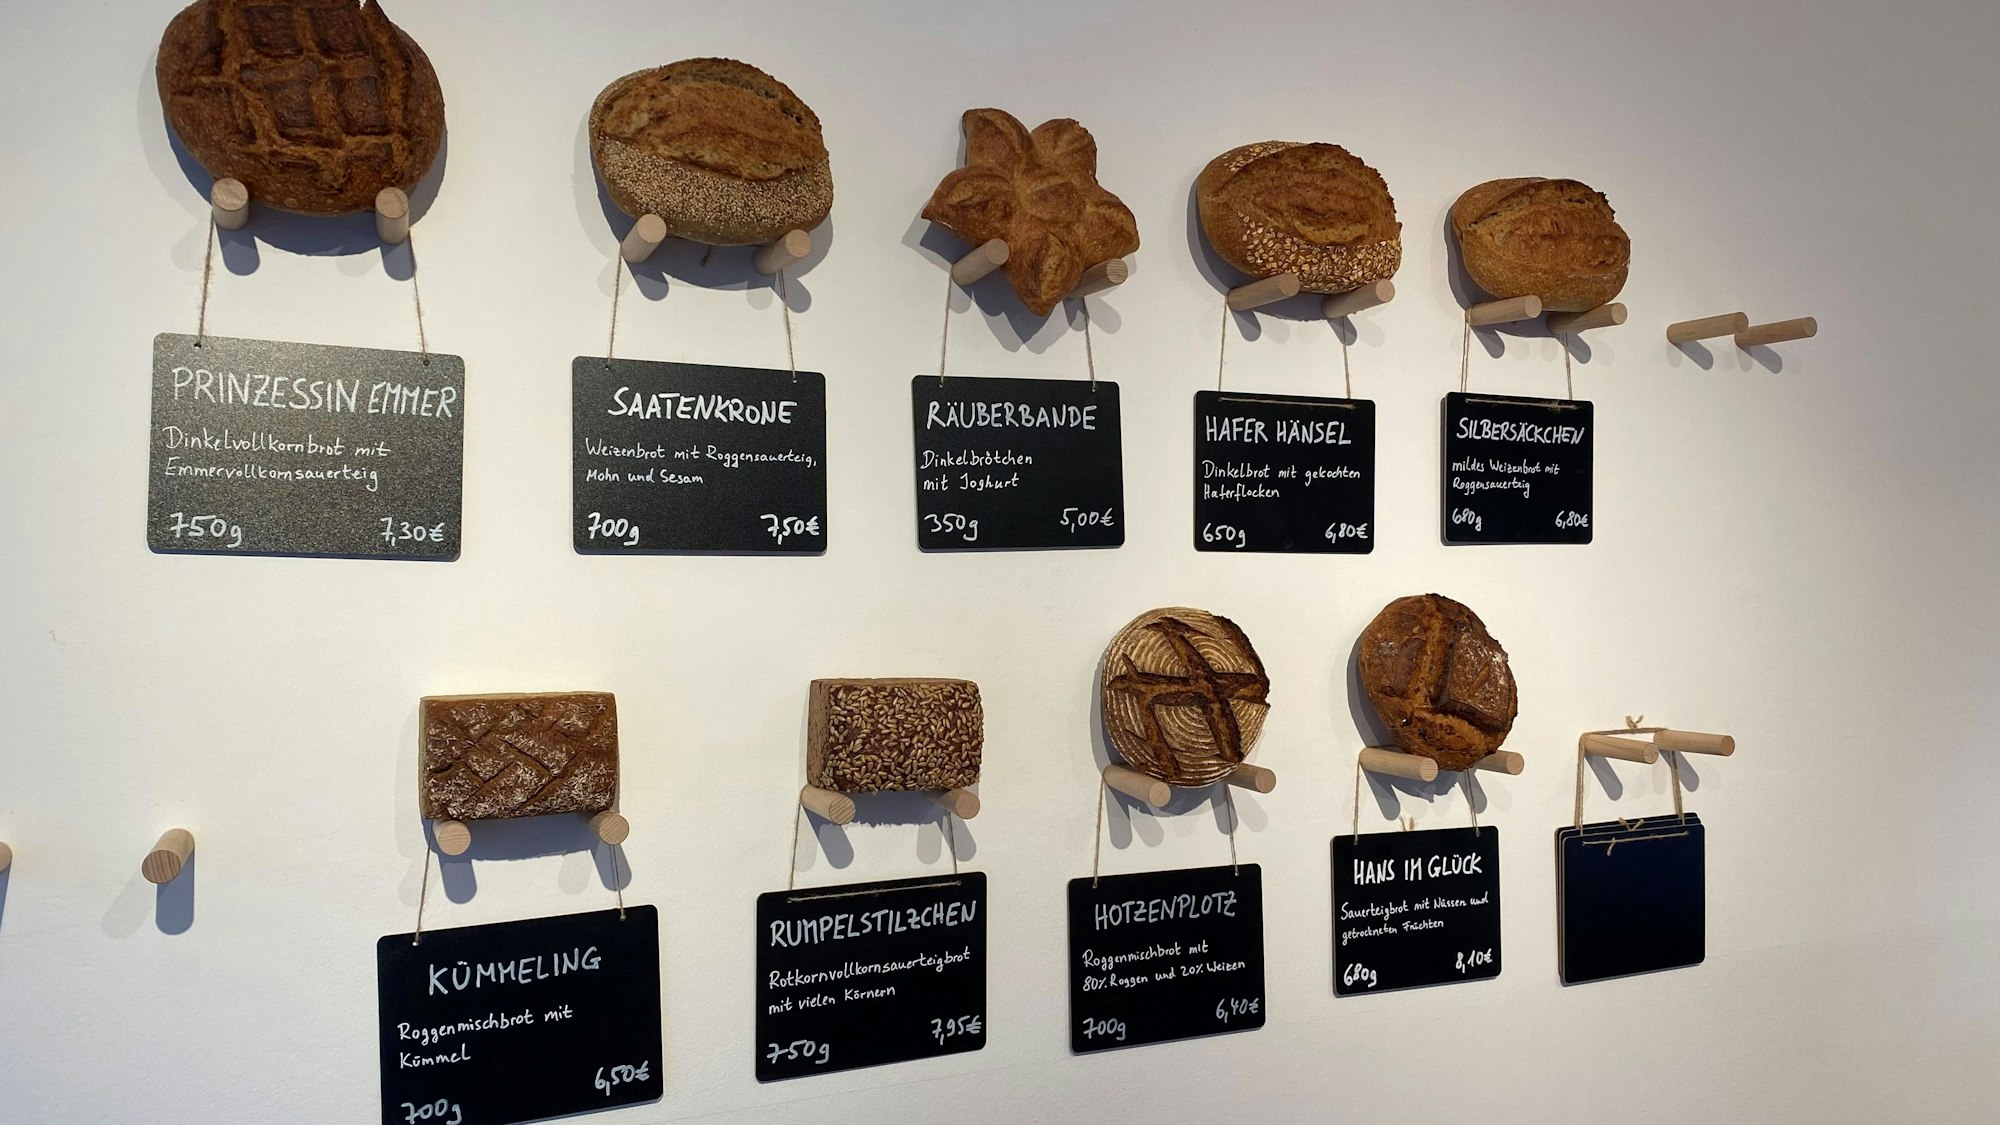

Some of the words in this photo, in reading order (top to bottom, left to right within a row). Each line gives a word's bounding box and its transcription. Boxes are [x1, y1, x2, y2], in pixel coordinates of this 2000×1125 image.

[172, 367, 359, 413] PRINZESSIN
[368, 381, 457, 418] EMMER
[608, 387, 797, 425] SAATENKRONE
[926, 401, 1097, 430] RÄUBERBANDE
[163, 426, 345, 455] Dinkelvollkornbrot
[355, 442, 391, 456] mit
[1206, 415, 1268, 443] HAFER
[1276, 420, 1351, 445] HÄNSEL
[1456, 417, 1585, 445] SILBERSÄCKCHEN
[585, 437, 665, 459] Weizenbrot
[675, 445, 700, 460] mit
[706, 445, 817, 468] Roggensauerteig,
[920, 450, 1032, 469] Dinkelbrötchen
[1452, 456, 1484, 472] mildes
[1489, 459, 1541, 474] Weizenbrot
[1545, 463, 1560, 474] mit
[165, 456, 378, 492] Emmervollkornsauerteig
[587, 468, 619, 482] Mohn
[628, 469, 654, 483] und
[660, 469, 703, 484] Sesam
[924, 474, 948, 490] mit
[960, 472, 1019, 491] Joghurt
[1202, 460, 1270, 478] Dinkelbrot
[1278, 465, 1297, 478] mit
[1305, 466, 1360, 486] gekochten
[1204, 483, 1280, 502] Haferflocken
[1453, 477, 1530, 498] Roggensauerteig
[169, 512, 242, 548] 750g
[380, 517, 445, 546] 7,30€
[588, 512, 640, 546] 700g
[760, 514, 820, 544] 7,50€
[924, 513, 978, 541] 350g
[1060, 507, 1114, 533] 5,00€
[1325, 522, 1368, 543] 6,80€
[1452, 508, 1481, 532] 680g
[1555, 510, 1588, 529] 6,80€
[1202, 522, 1246, 548] 650g
[1354, 859, 1395, 885] HANS
[1405, 858, 1422, 881] IM
[1428, 852, 1482, 878] GLÜCK
[1095, 891, 1237, 931] HOTZENPLOTZ
[1341, 900, 1409, 921] Sauerteigbrot
[1414, 897, 1429, 910] mit
[1434, 897, 1466, 909] Nüssen
[1470, 891, 1488, 905] und
[770, 900, 977, 948] RUMPELSTILZCHEN
[1342, 923, 1397, 946] getrockneten
[769, 946, 970, 989] Rotkornvollkornsauerteigbrot
[1082, 942, 1181, 971] Roggenmischbrot
[1189, 940, 1208, 955] mit
[1456, 948, 1492, 973] 8,10€
[428, 946, 602, 996] KÜMMELING
[1110, 974, 1148, 988] Roggen
[1155, 968, 1176, 980] und
[1207, 960, 1245, 973] Weizen
[1343, 963, 1377, 988] 680g
[769, 998, 792, 1015] mit
[799, 994, 836, 1009] vielen
[845, 987, 896, 1001] Körnern
[1216, 998, 1259, 1023] 6,40€
[397, 1009, 534, 1045] Roggenmischbrot
[544, 1005, 572, 1022] mit
[931, 1015, 982, 1045] 7,95€
[1083, 1018, 1126, 1040] 700g
[400, 1043, 471, 1069] Kümmel
[767, 1040, 830, 1064] 750g
[595, 1060, 650, 1096] 6,50€
[401, 1098, 463, 1125] 700g
